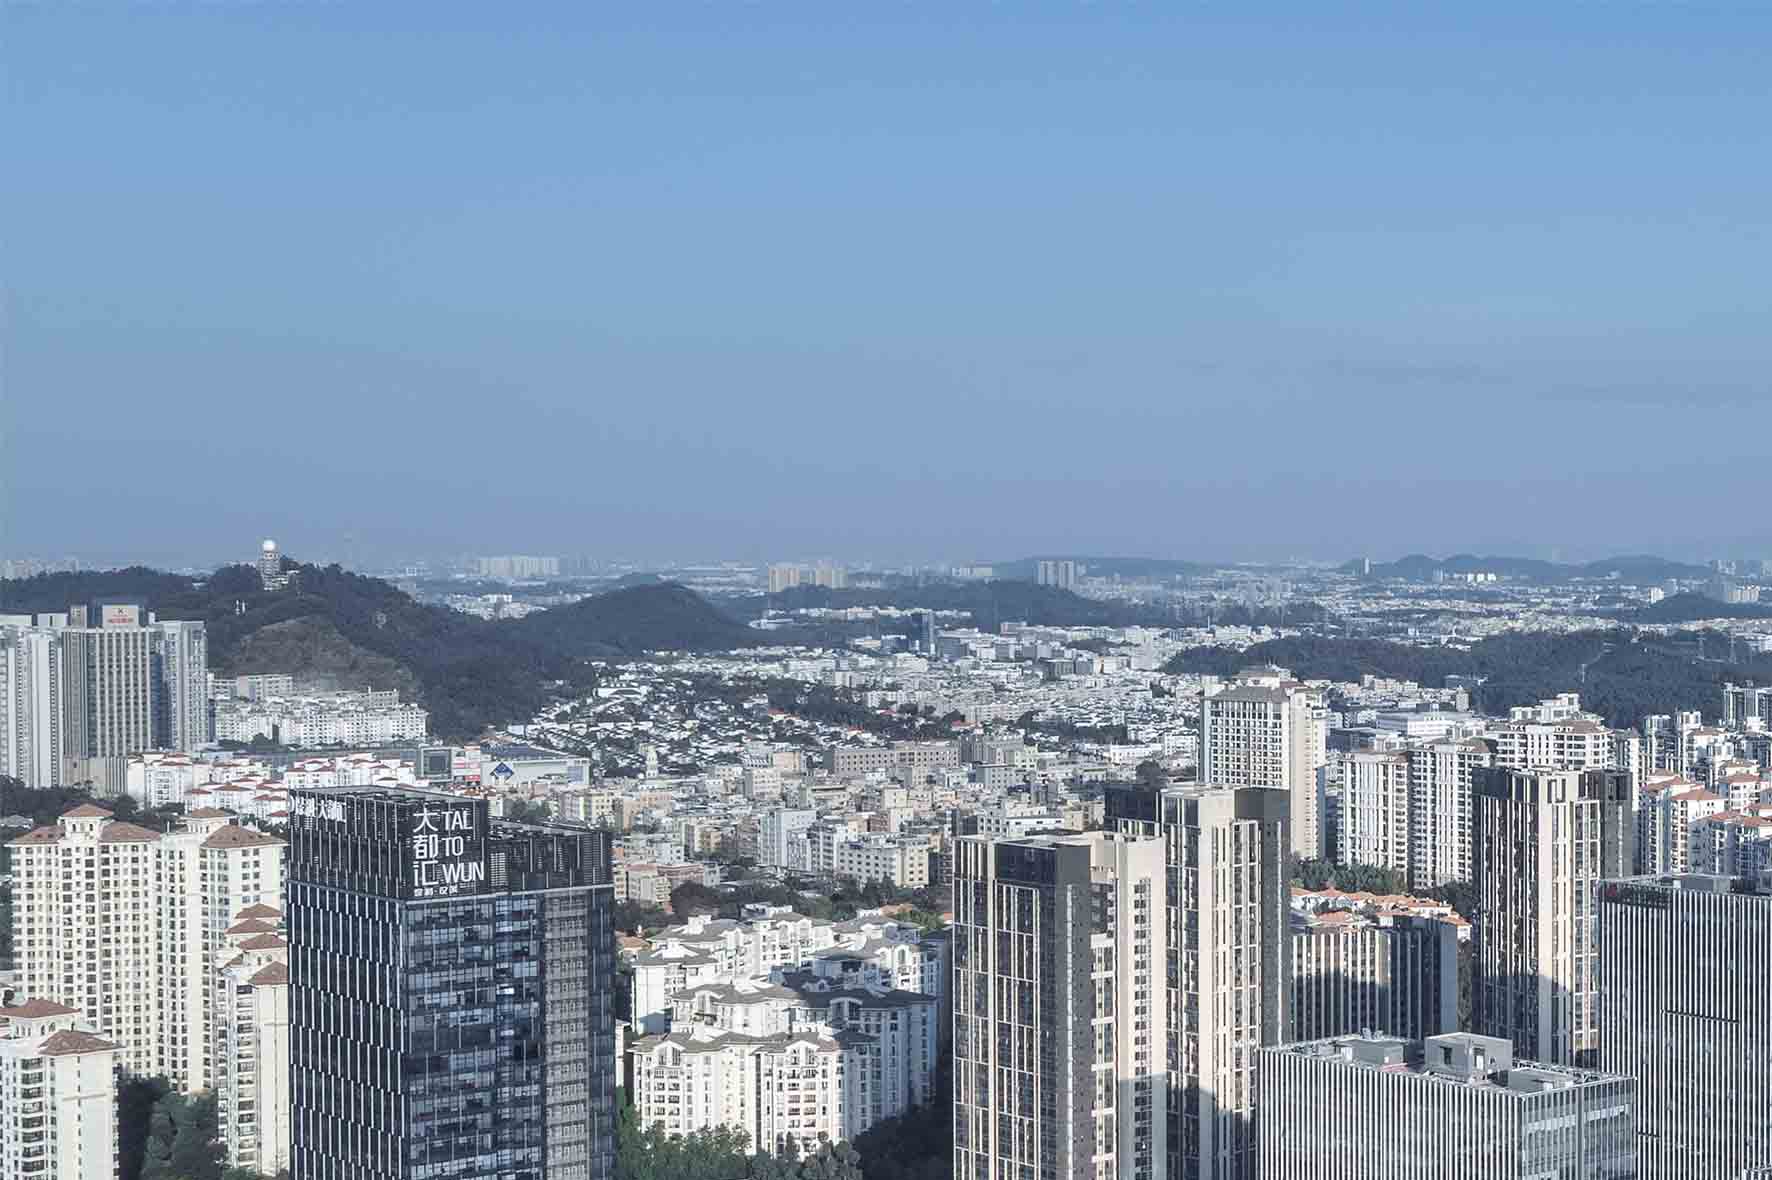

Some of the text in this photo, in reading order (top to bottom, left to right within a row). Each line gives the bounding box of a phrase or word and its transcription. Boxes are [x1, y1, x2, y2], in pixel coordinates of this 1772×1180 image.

[441, 811, 473, 831] TAL
[441, 836, 464, 857] TO
[441, 861, 485, 884] WUN
